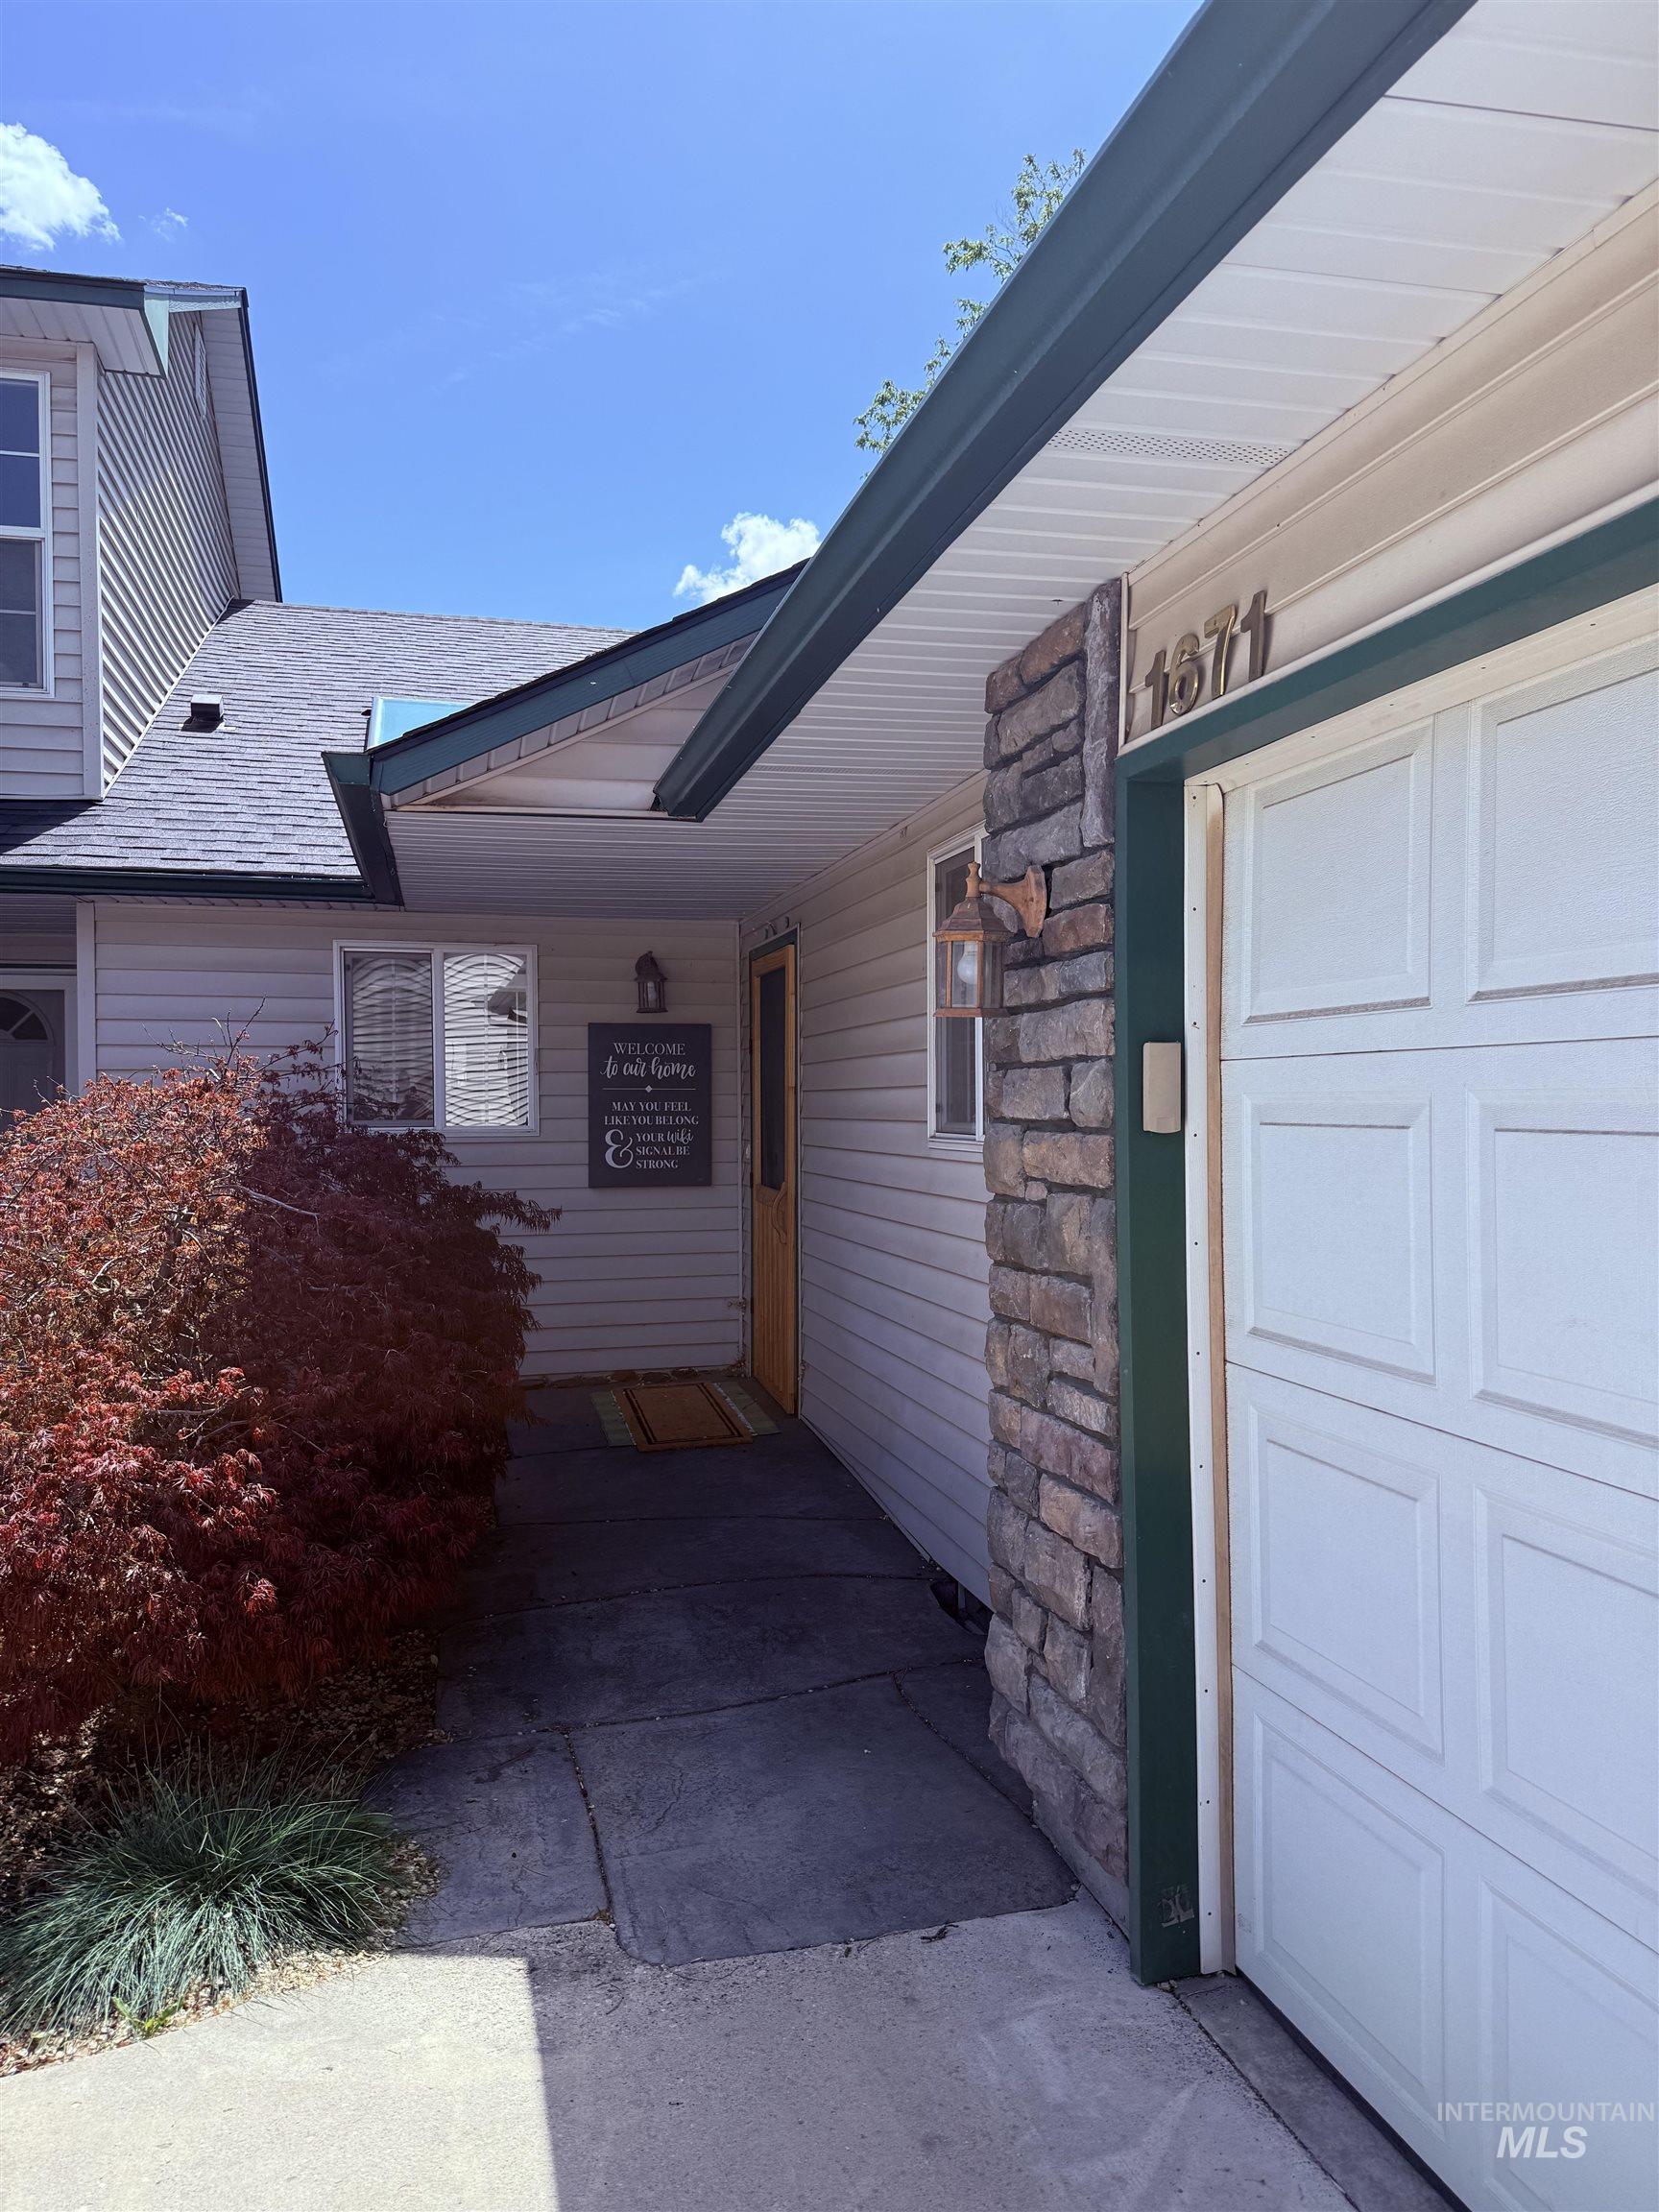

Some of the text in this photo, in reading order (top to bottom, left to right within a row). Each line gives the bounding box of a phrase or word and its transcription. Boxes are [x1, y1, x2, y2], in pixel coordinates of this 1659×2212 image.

[1144, 589, 1267, 731] 1671
[613, 1043, 685, 1055] WELCOME
[600, 1055, 696, 1079] to our home
[612, 1101, 691, 1112] MAY YOU FEEL
[604, 1116, 699, 1125] LIKE YOU BELONG
[605, 1128, 693, 1168] & YOUR wifi
[636, 1145, 690, 1156] SIGNAL BE
[636, 1159, 679, 1169] STRONG
